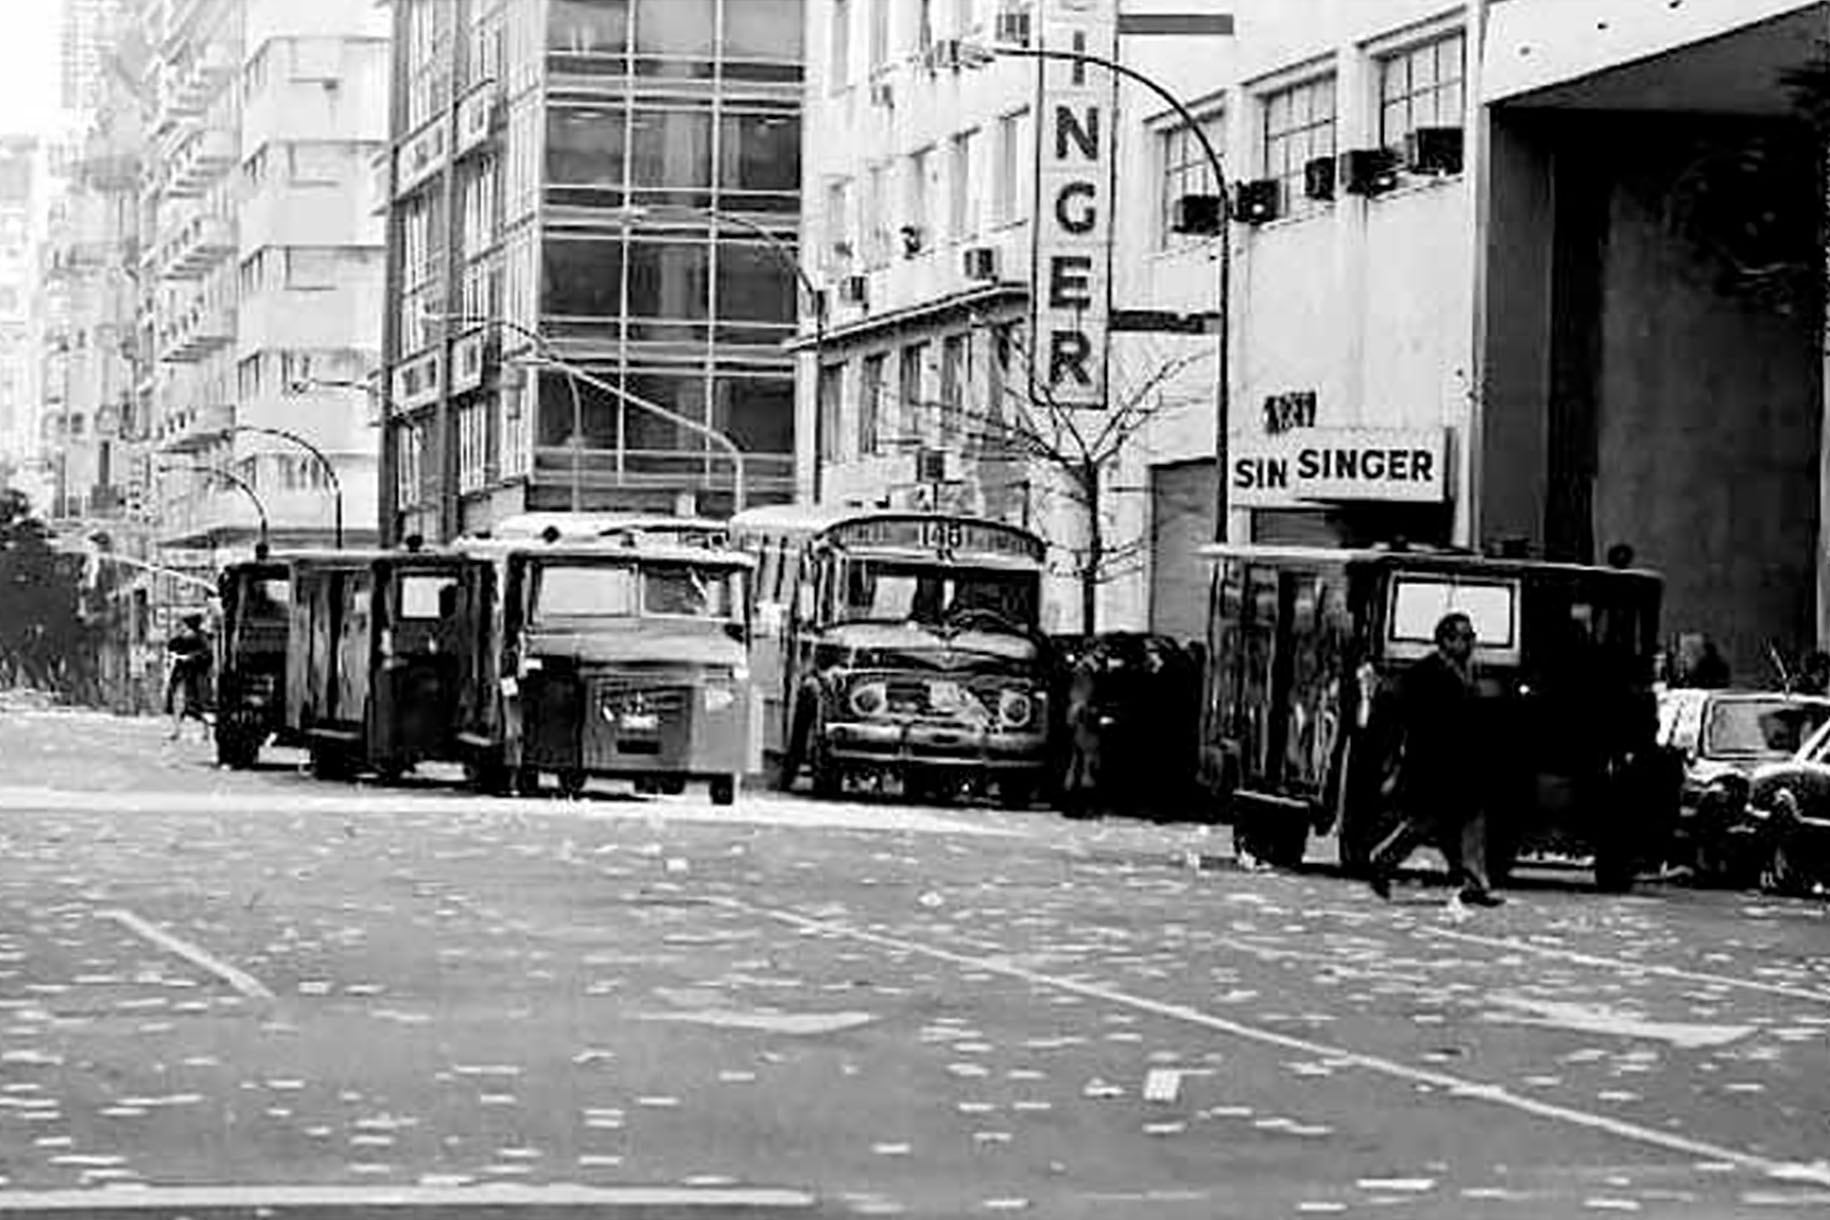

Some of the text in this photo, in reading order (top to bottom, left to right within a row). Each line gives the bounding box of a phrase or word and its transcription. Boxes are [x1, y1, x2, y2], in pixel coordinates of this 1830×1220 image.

[1049, 0, 1099, 386] INGER
[1234, 459, 1287, 488] SIN
[1298, 449, 1433, 481] SINGER
